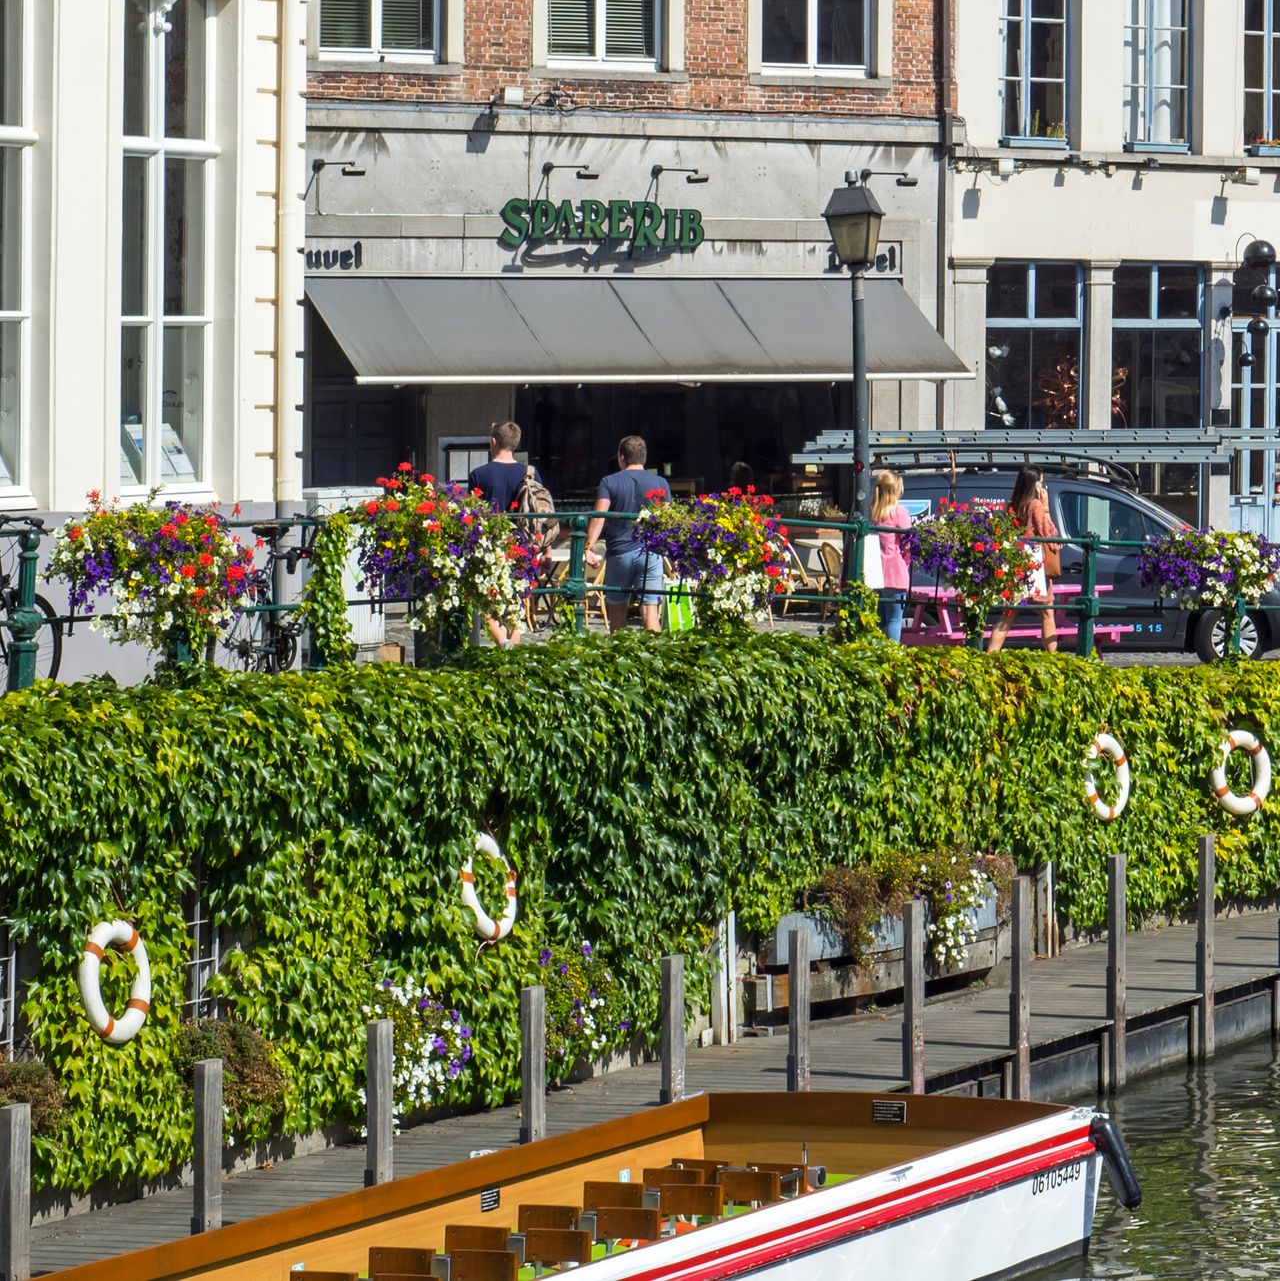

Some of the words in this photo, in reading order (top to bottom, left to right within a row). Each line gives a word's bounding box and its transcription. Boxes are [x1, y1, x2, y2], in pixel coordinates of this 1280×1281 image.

[305, 241, 363, 270] uvel
[1148, 623, 1163, 632] 15
[1032, 1161, 1081, 1196] 06105449
